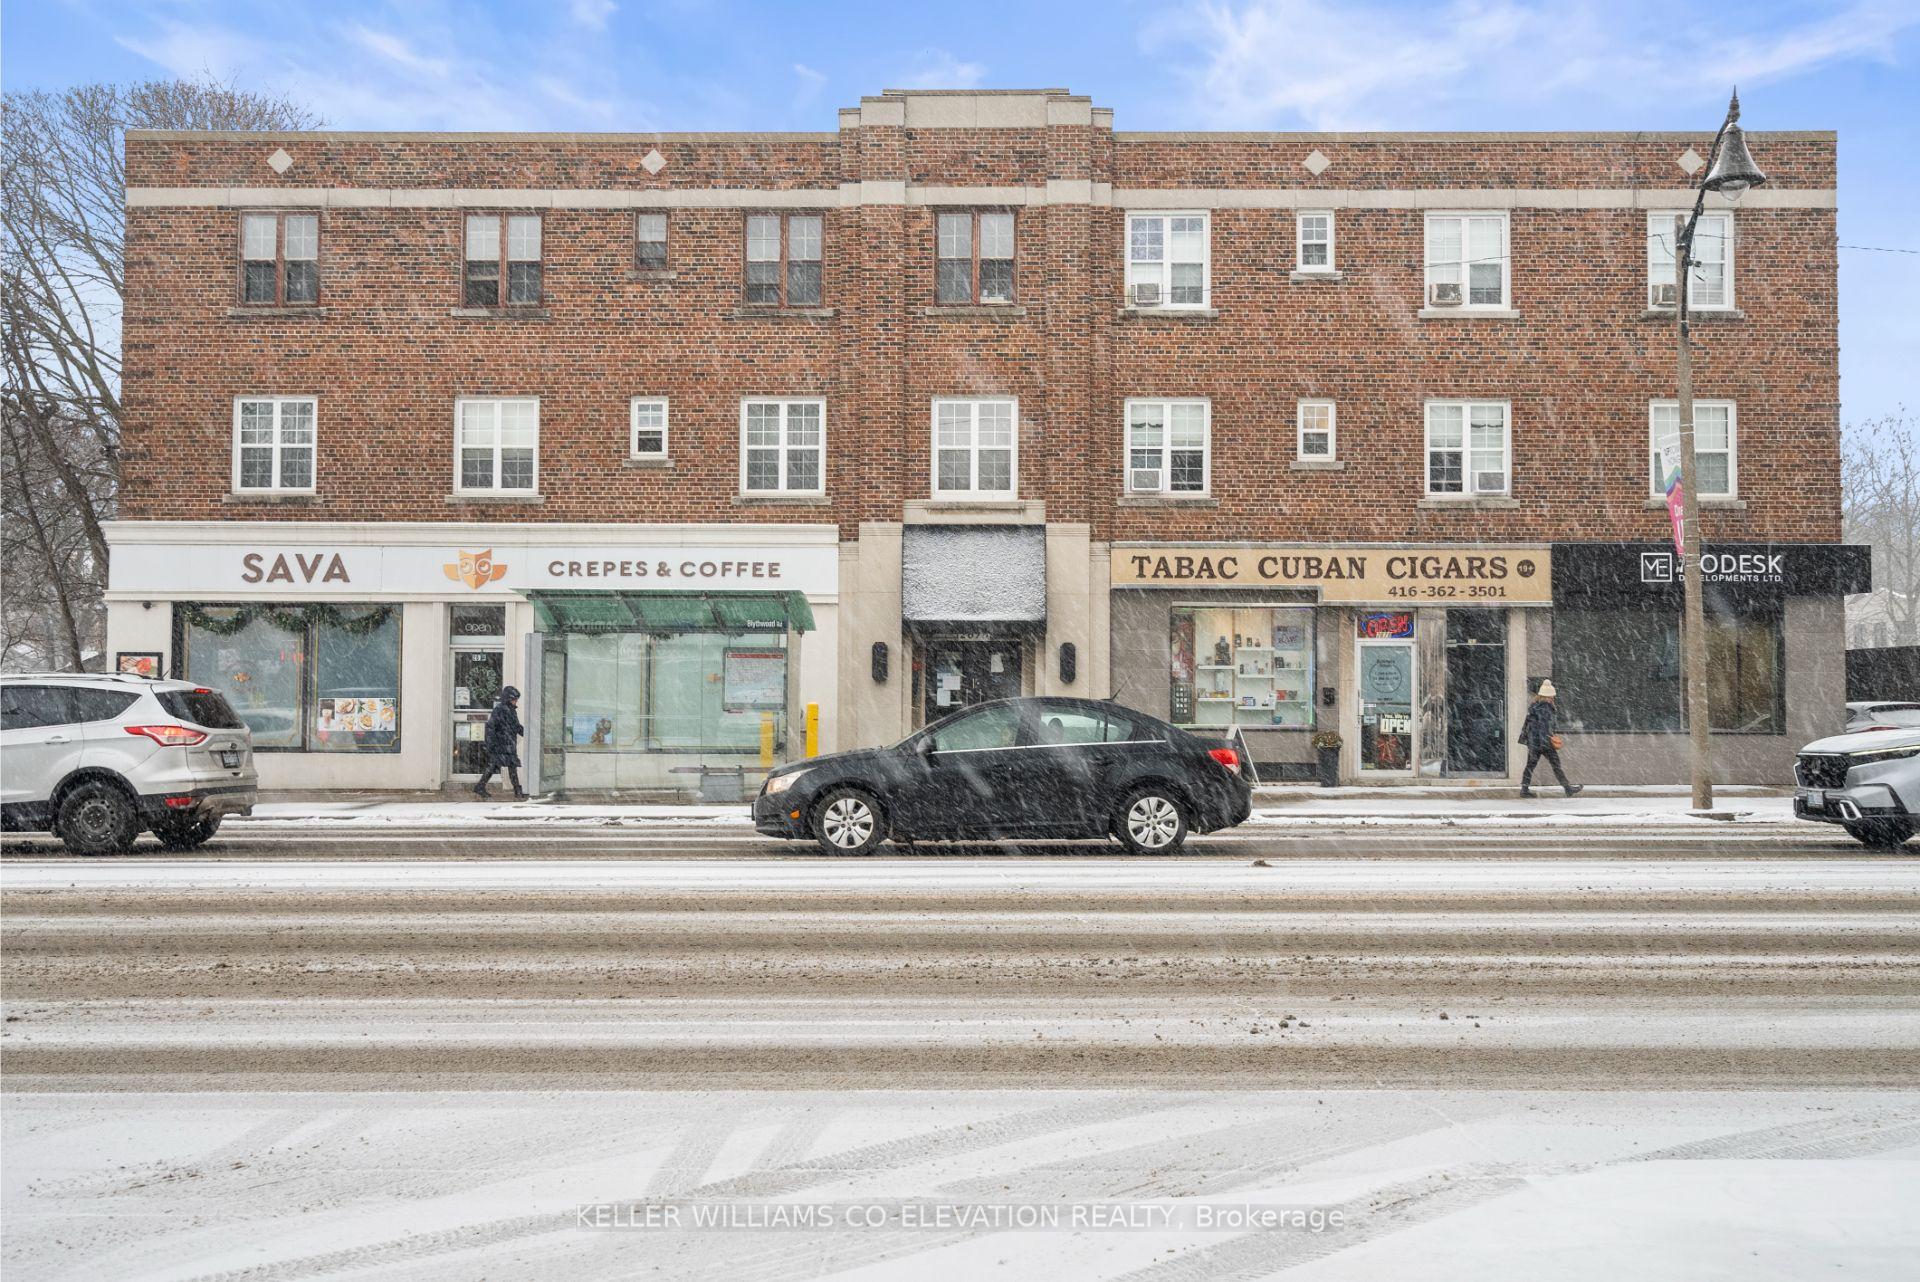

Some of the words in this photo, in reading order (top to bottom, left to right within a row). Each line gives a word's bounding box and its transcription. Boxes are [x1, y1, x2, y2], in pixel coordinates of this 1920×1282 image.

[241, 553, 351, 583] SAVA
[547, 560, 648, 577] CREPES
[656, 561, 671, 577] &
[679, 561, 781, 578] COFFEE
[1131, 555, 1239, 579] TABAC
[1257, 556, 1367, 579] CUBAN
[1386, 556, 1508, 579] CIGARS
[1679, 574, 1759, 582] DELOPMENTS
[465, 623, 492, 633] open
[747, 620, 776, 629] Blythwood
[1367, 614, 1409, 638] OPEN
[1380, 719, 1411, 733] OPEN
